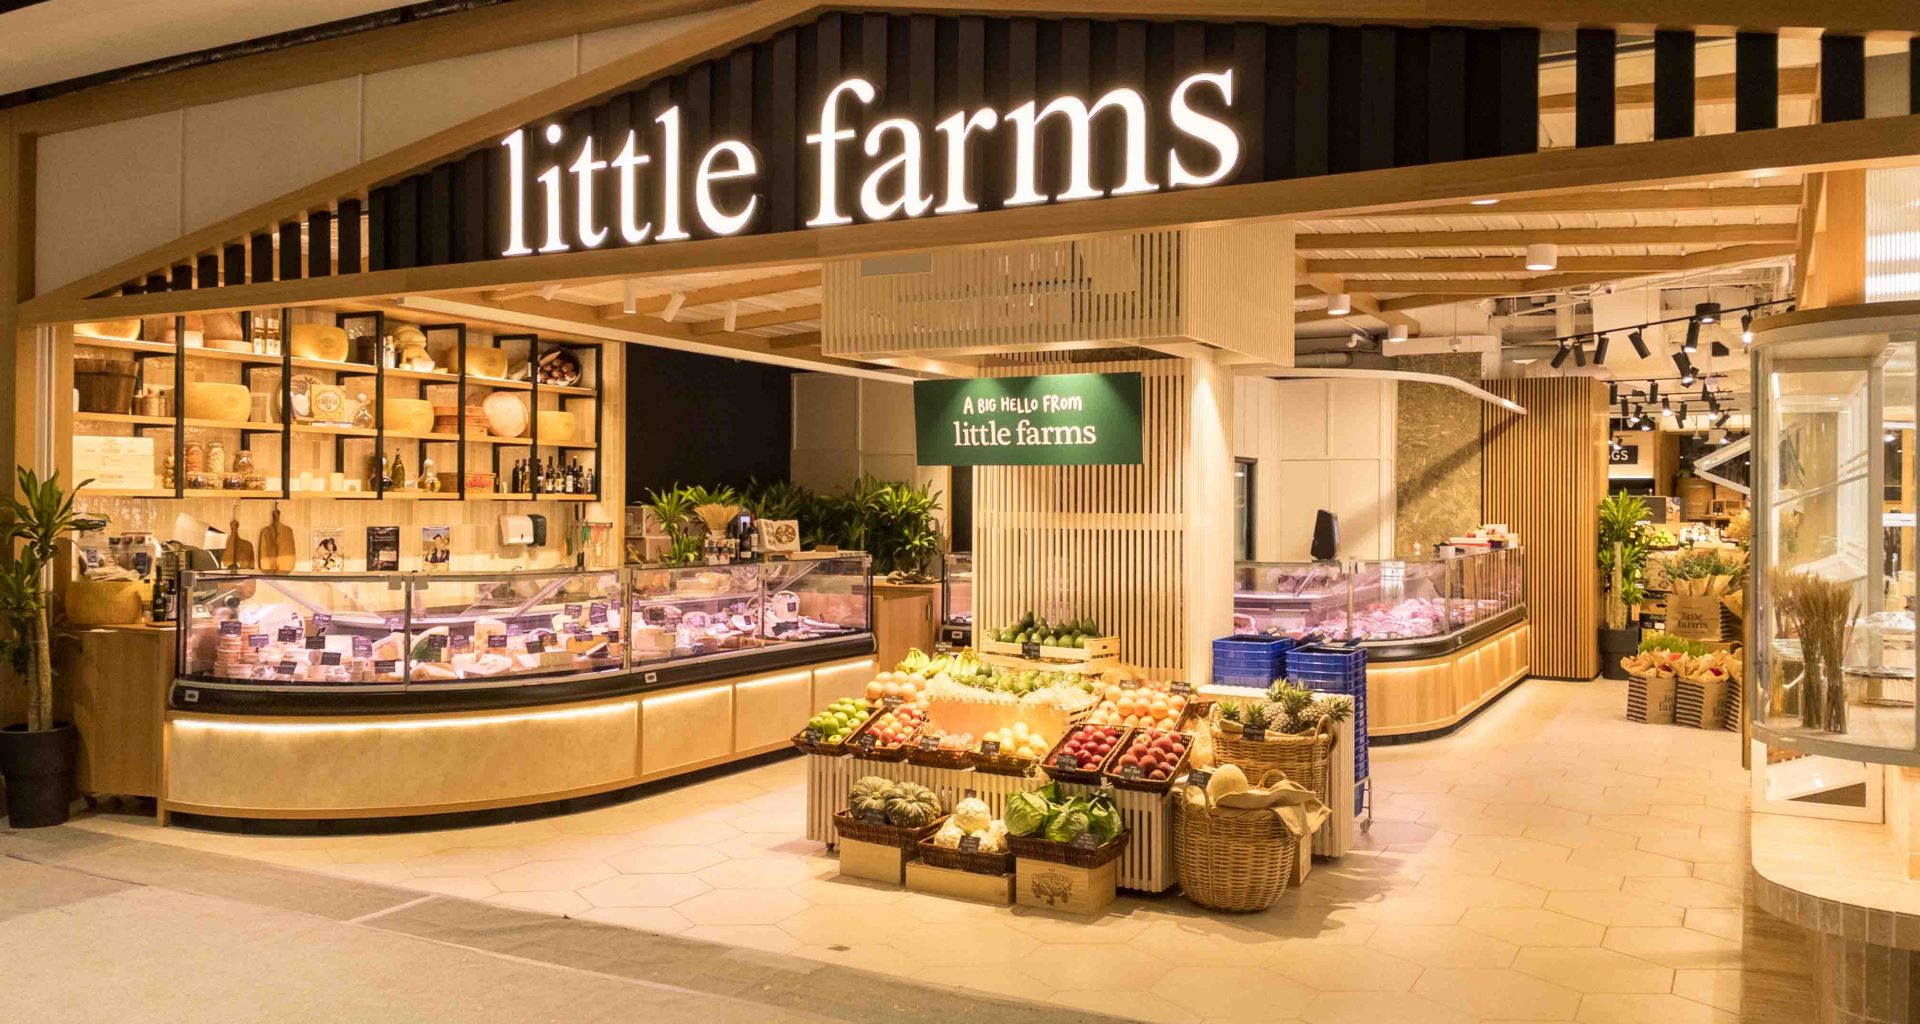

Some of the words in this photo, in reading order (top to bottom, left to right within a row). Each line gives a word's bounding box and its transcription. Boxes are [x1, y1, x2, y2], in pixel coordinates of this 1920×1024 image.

[501, 106, 757, 256] little
[804, 69, 1241, 228] farms
[962, 396, 974, 415] A
[977, 397, 997, 414] BIG
[1000, 396, 1039, 414] HELLO
[953, 419, 1011, 446] little
[1016, 419, 1097, 446] farms
